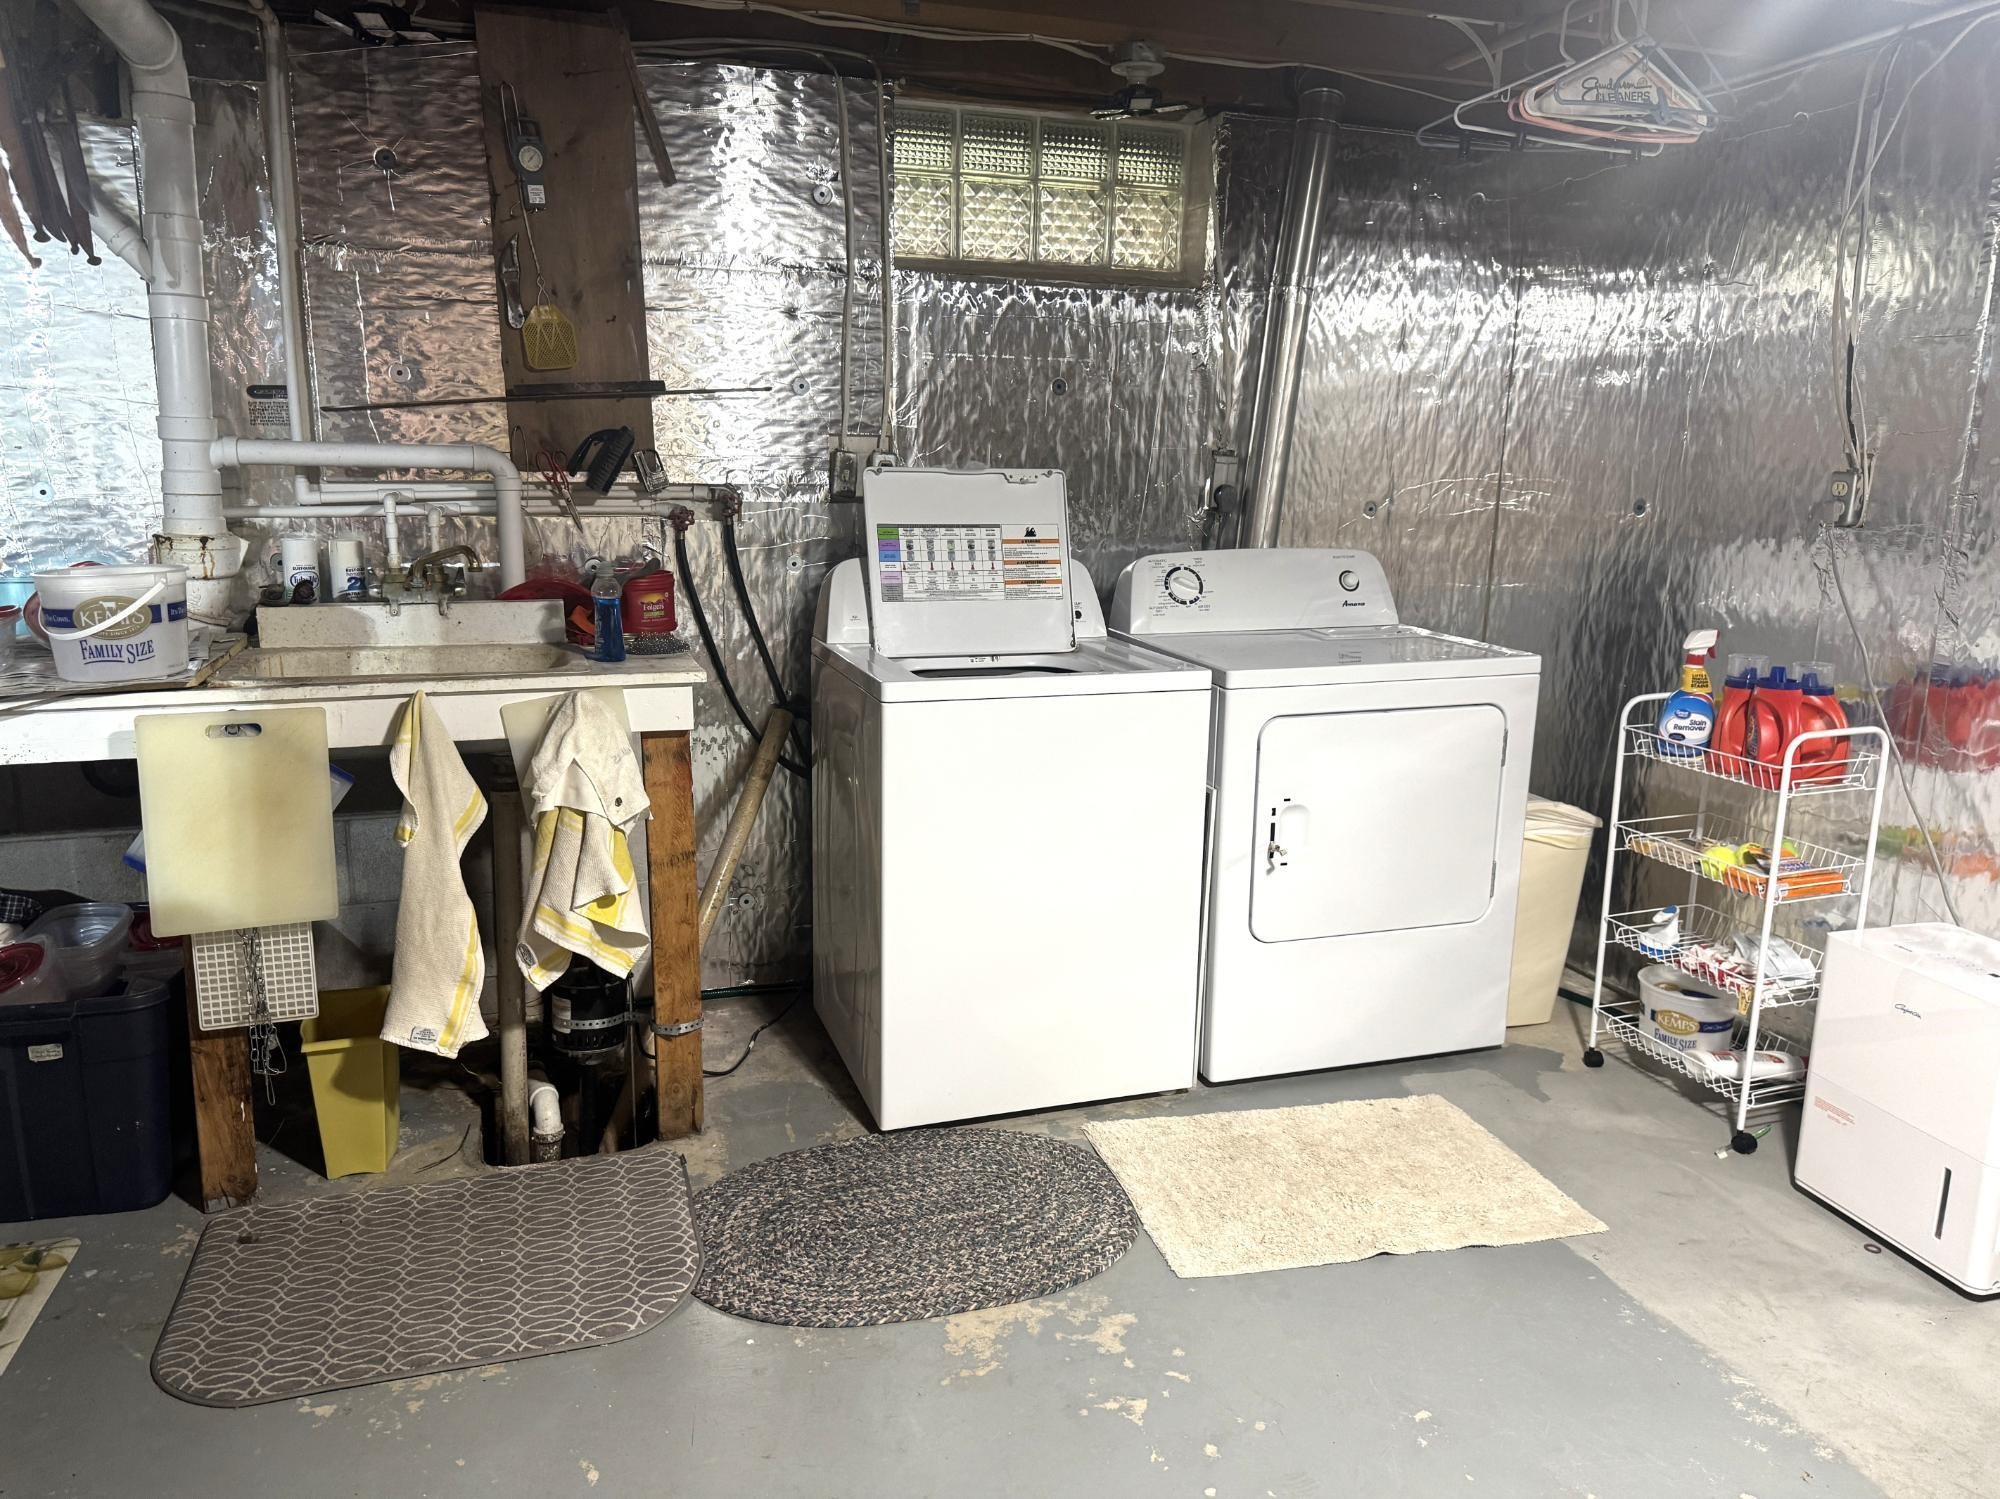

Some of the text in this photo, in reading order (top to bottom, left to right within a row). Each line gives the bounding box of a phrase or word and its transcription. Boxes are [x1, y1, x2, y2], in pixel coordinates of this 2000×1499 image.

[79, 639, 154, 664] FAMILY SIZE
[1673, 723, 1706, 731] Remover
[1657, 1013, 1697, 1032] KEMPS
[1679, 1039, 1697, 1052] SIZE
